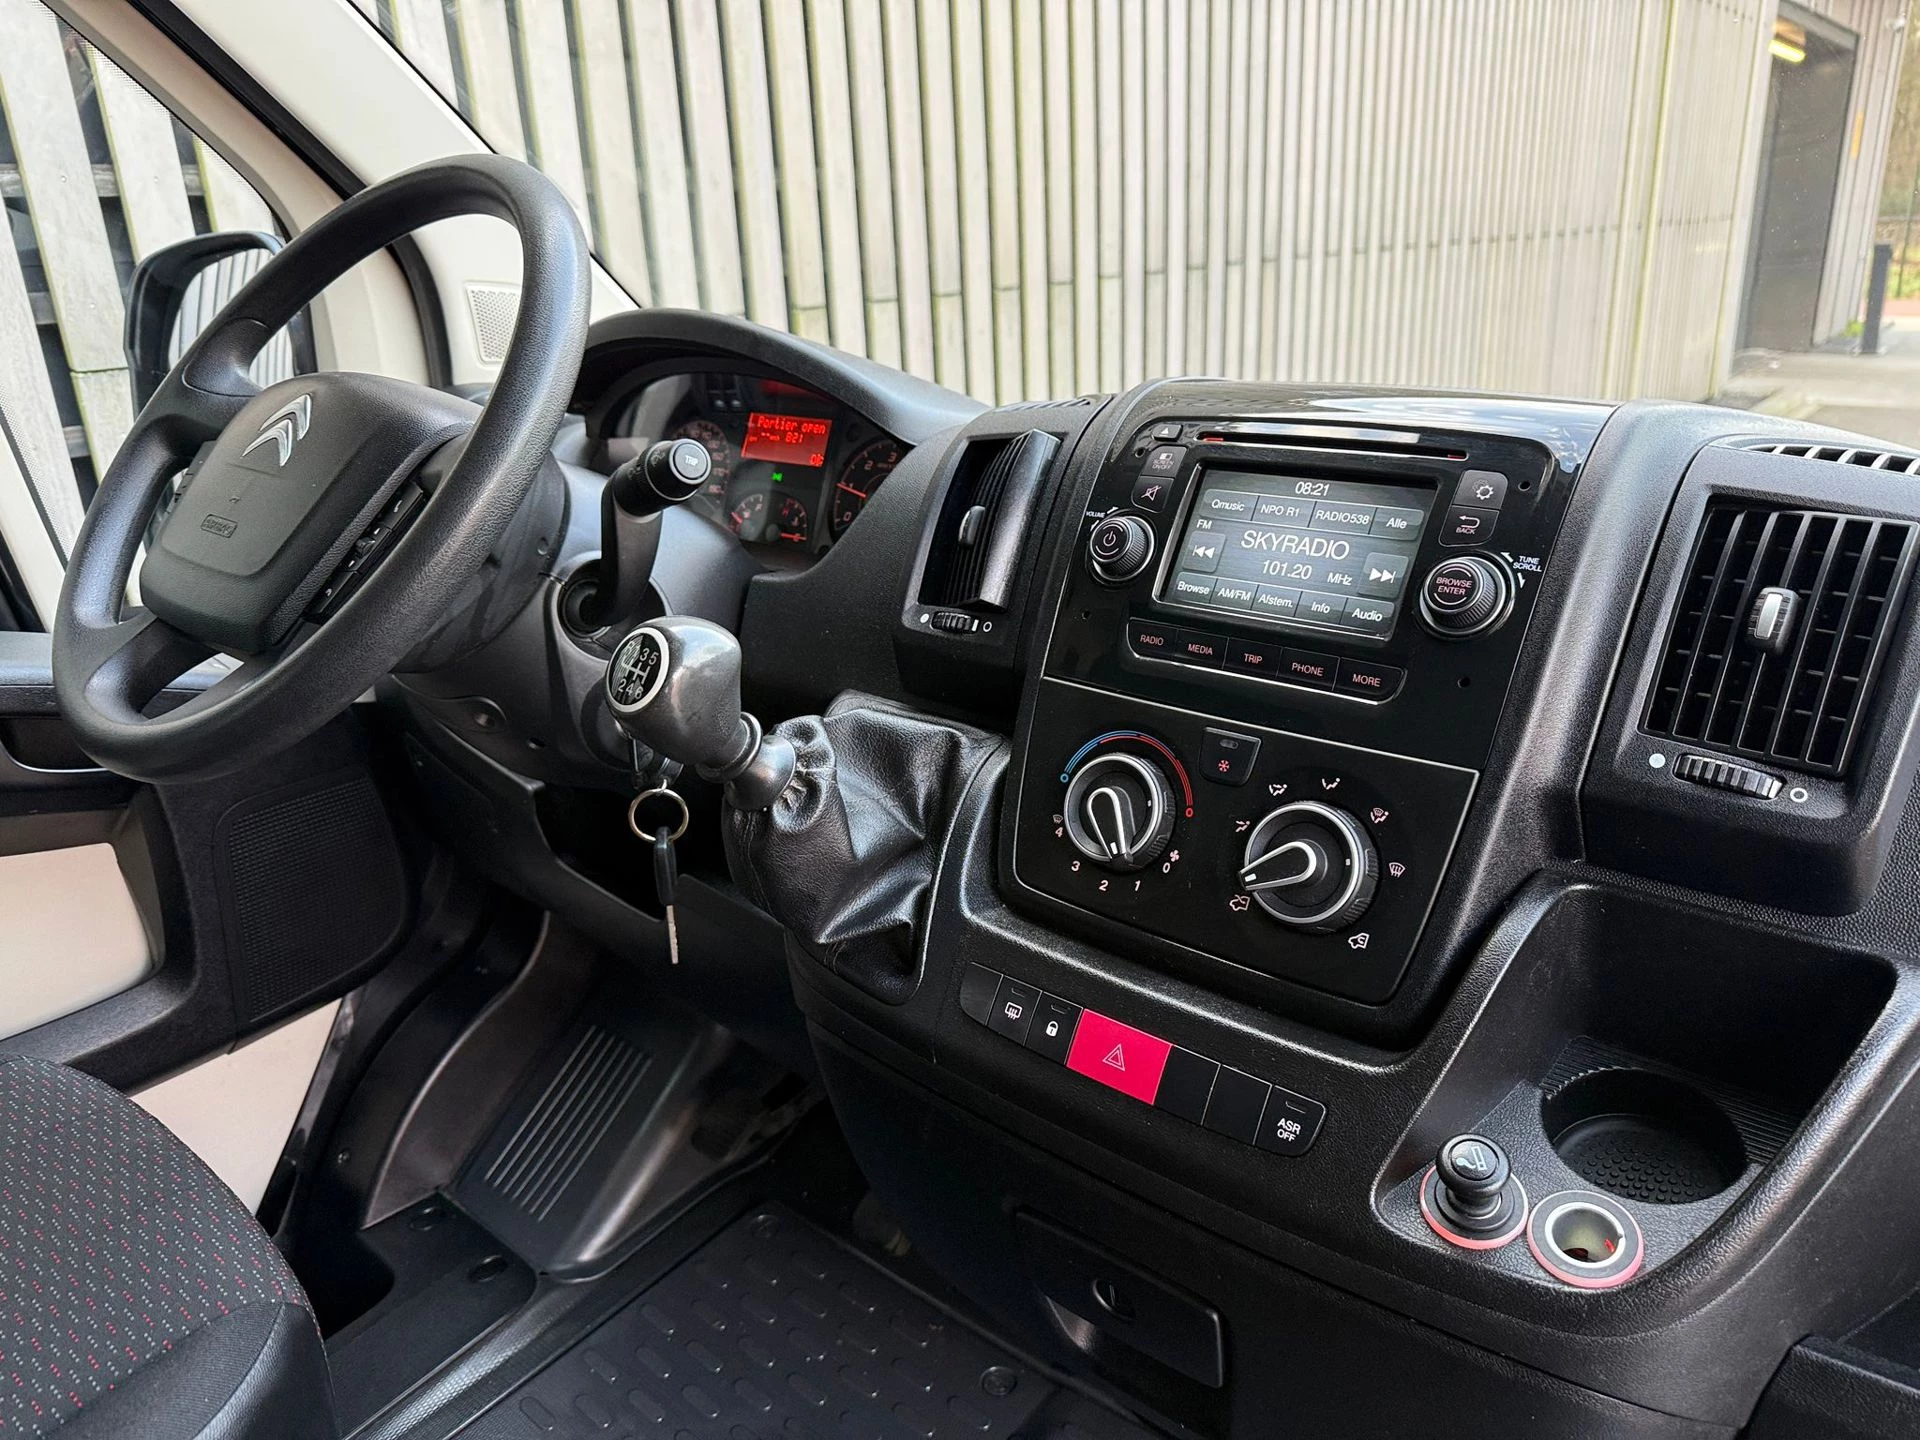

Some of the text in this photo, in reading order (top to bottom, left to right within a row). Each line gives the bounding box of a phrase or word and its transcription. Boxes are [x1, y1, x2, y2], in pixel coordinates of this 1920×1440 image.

[1295, 481, 1330, 497] 08:21
[1211, 498, 1245, 512] Qmusic
[1260, 503, 1300, 517] NPO R1
[1315, 509, 1370, 525] RADIO538
[1386, 516, 1408, 529] Alle
[1196, 520, 1212, 529] FM
[1455, 526, 1476, 535] BACK
[1240, 529, 1350, 560] SKYRADIO
[1518, 555, 1540, 565] TUNE
[1262, 559, 1353, 586] 101.20 MHz
[1512, 562, 1542, 573] SCROLL
[1177, 580, 1210, 595] Browse
[1435, 576, 1473, 589] BROWSE
[1217, 587, 1251, 601] AM/FM
[1437, 585, 1466, 596] ENTER
[1311, 601, 1331, 614] Info
[1351, 607, 1383, 622] Audio
[1140, 633, 1164, 646] RADIO
[639, 647, 650, 662] 3
[648, 651, 660, 665] 5
[1187, 643, 1213, 656] MEDIA
[1244, 653, 1263, 665] TRIP
[1291, 662, 1325, 677] PHONE
[1352, 673, 1382, 687] MORE
[618, 678, 644, 700] 2 4 6
[1055, 826, 1064, 838] 4
[1071, 860, 1081, 872] 3
[1098, 879, 1109, 891] 2
[1134, 880, 1141, 891] 1
[1277, 1117, 1301, 1135] ASR
[1277, 1128, 1297, 1142] OFF
